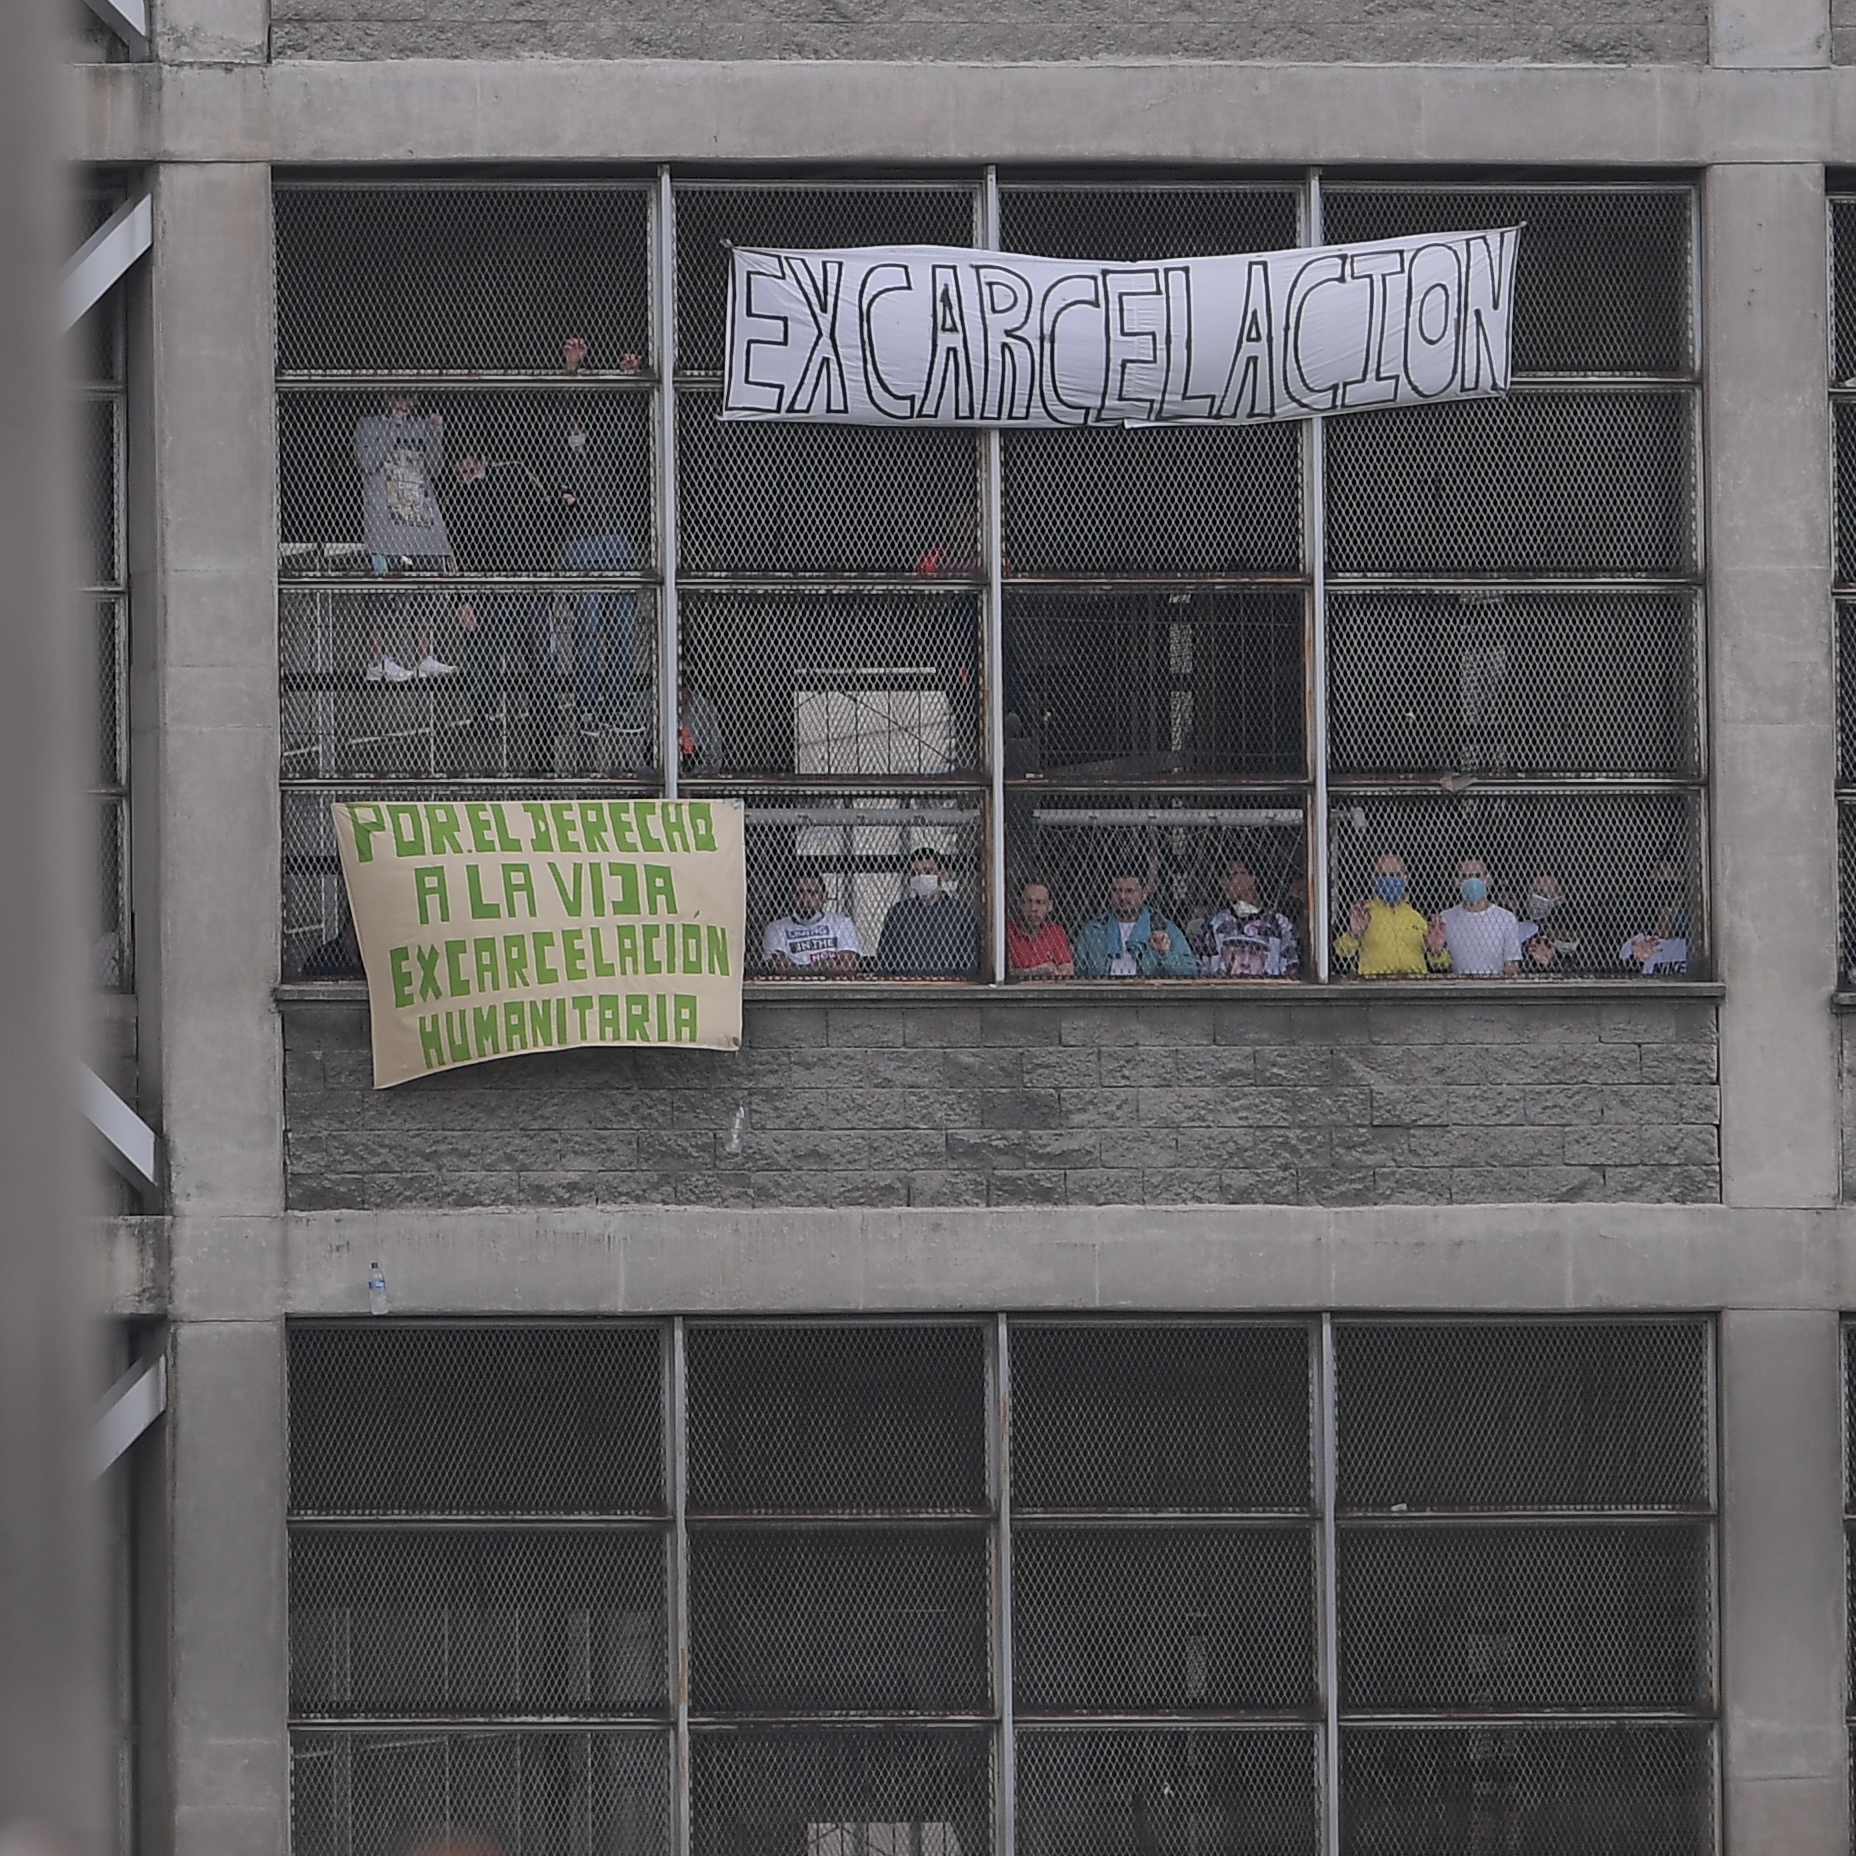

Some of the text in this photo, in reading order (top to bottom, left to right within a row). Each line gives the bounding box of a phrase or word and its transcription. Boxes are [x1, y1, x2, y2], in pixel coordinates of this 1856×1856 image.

[725, 229, 1516, 425] EXCARCELACION
[347, 801, 718, 863] POR EL DERECHO
[414, 865, 450, 925] A
[466, 862, 537, 920] LA
[418, 993, 698, 1069] HUMANITARIA
